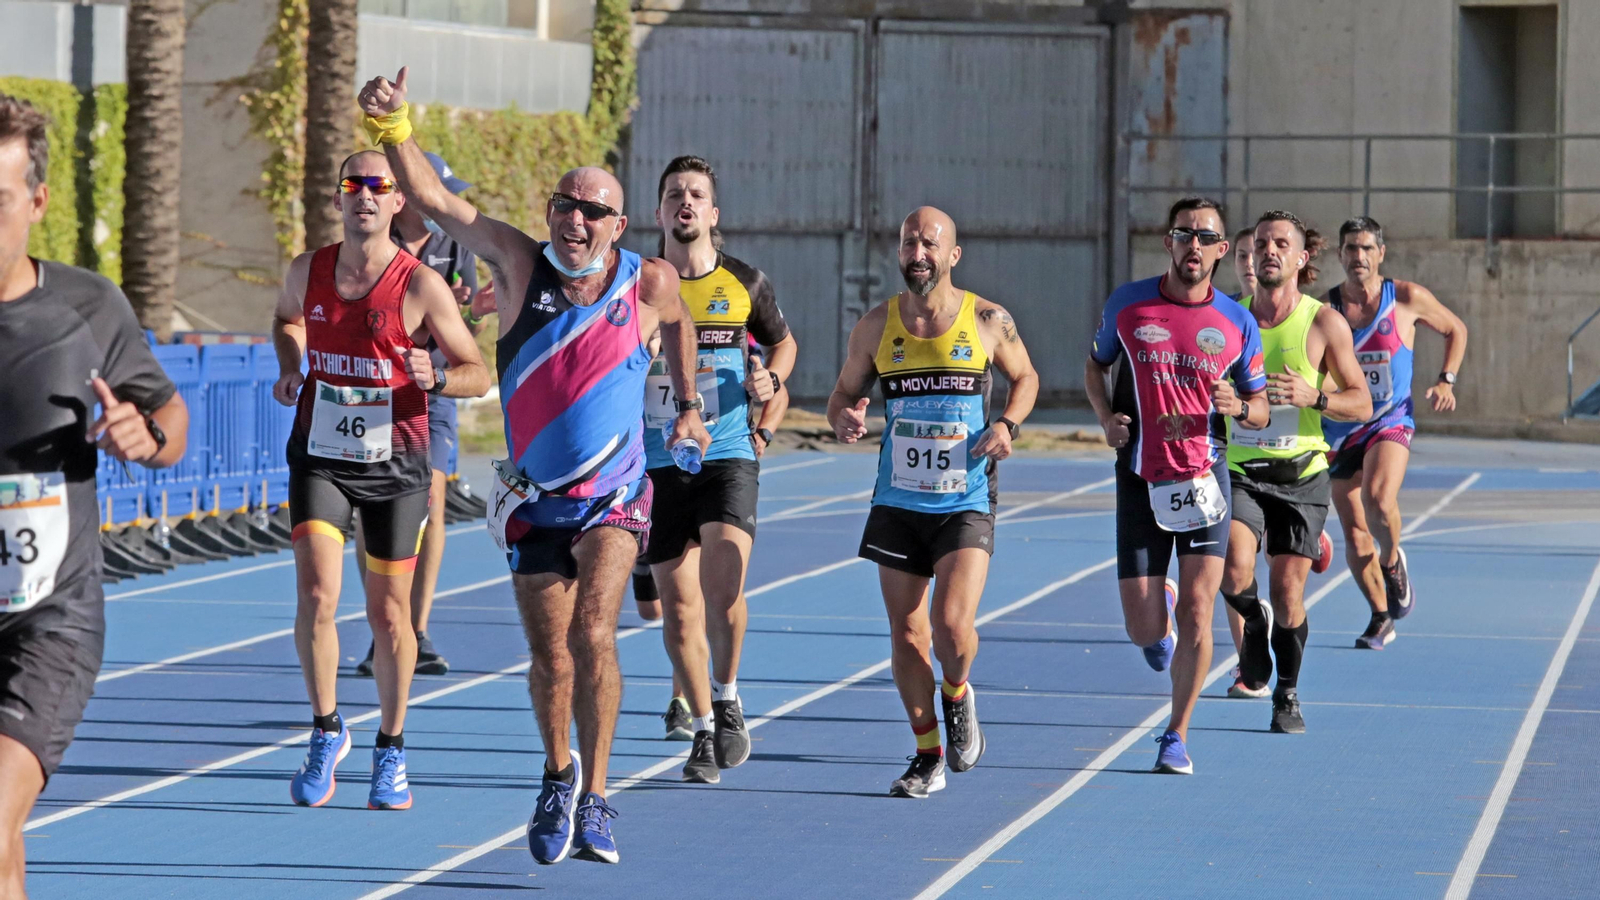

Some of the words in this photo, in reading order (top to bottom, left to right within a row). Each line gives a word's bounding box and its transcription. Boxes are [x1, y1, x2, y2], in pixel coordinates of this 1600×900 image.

[531, 302, 557, 313] VIATOR
[698, 330, 734, 344] JEREZ
[1137, 349, 1219, 375] GADEIRAS
[901, 376, 975, 392] MOVIJEREZ
[1152, 370, 1200, 389] SPORT
[657, 385, 671, 406] 7
[905, 400, 972, 411] RUBYSAN
[335, 415, 366, 439] 46
[906, 447, 951, 471] 915
[1170, 486, 1208, 512] 543
